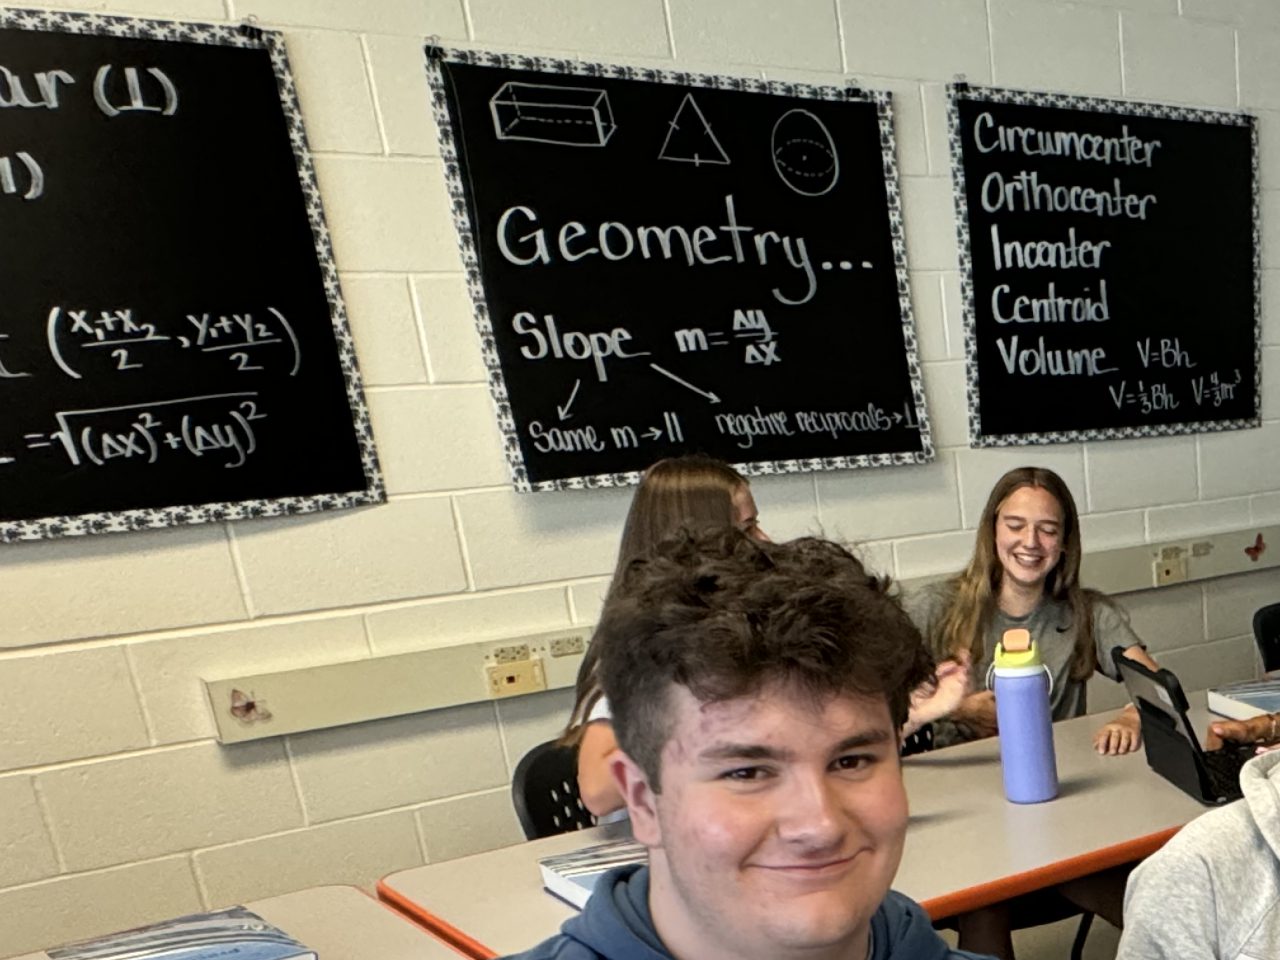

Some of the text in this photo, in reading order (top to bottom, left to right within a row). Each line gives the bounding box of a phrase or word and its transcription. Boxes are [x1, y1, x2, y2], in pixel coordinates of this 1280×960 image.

[973, 112, 1161, 168] Circumcenter
[981, 170, 1157, 220] Orthocenter
[497, 194, 873, 305] Geometry...
[990, 224, 1112, 271] Incenter
[991, 279, 1110, 324] Centroid
[512, 312, 652, 382] Slope
[996, 335, 1119, 376] Volume
[528, 420, 605, 453] Same
[715, 406, 795, 449] negative
[795, 402, 892, 440] reciprocals
